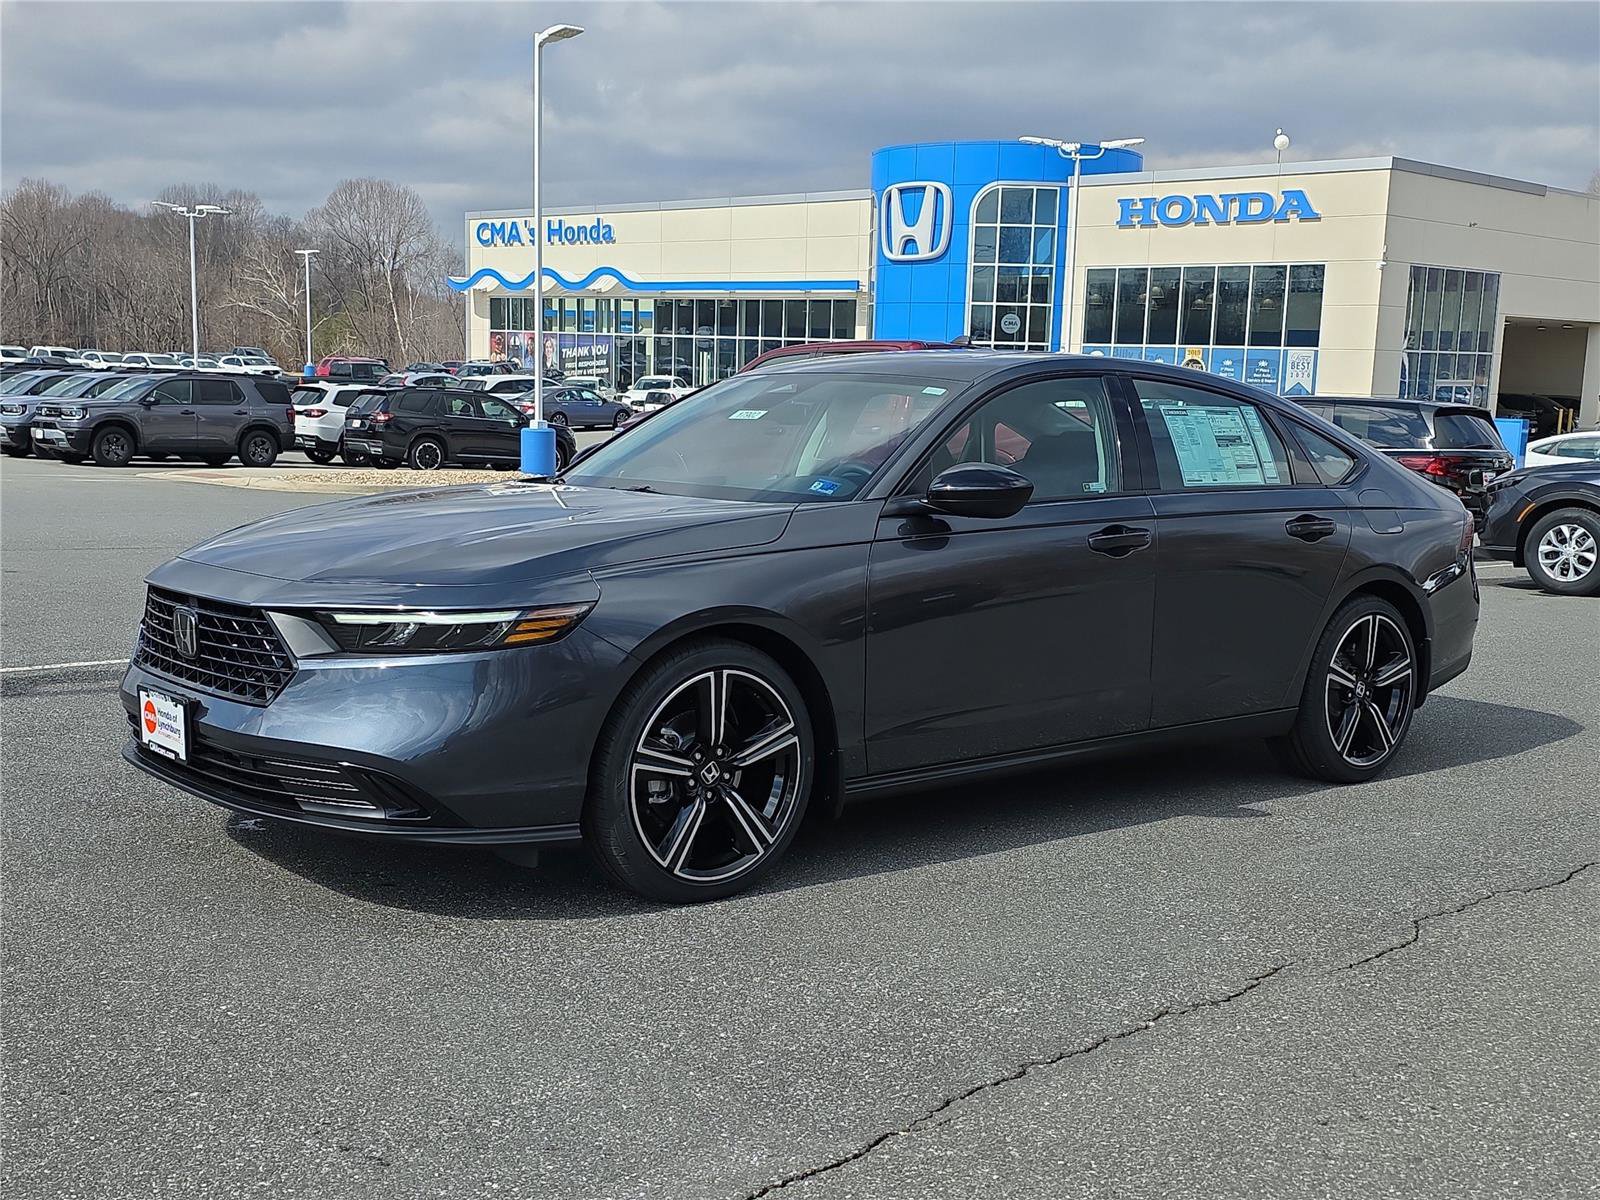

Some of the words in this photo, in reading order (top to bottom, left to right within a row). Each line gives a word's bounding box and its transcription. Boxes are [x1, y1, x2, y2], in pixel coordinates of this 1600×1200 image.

[1116, 190, 1321, 229] HONDA
[547, 217, 616, 246] Honda
[562, 346, 590, 358] THANK
[591, 344, 609, 356] YOU
[1290, 361, 1311, 370] BEST
[158, 717, 181, 739] Lynchburg
